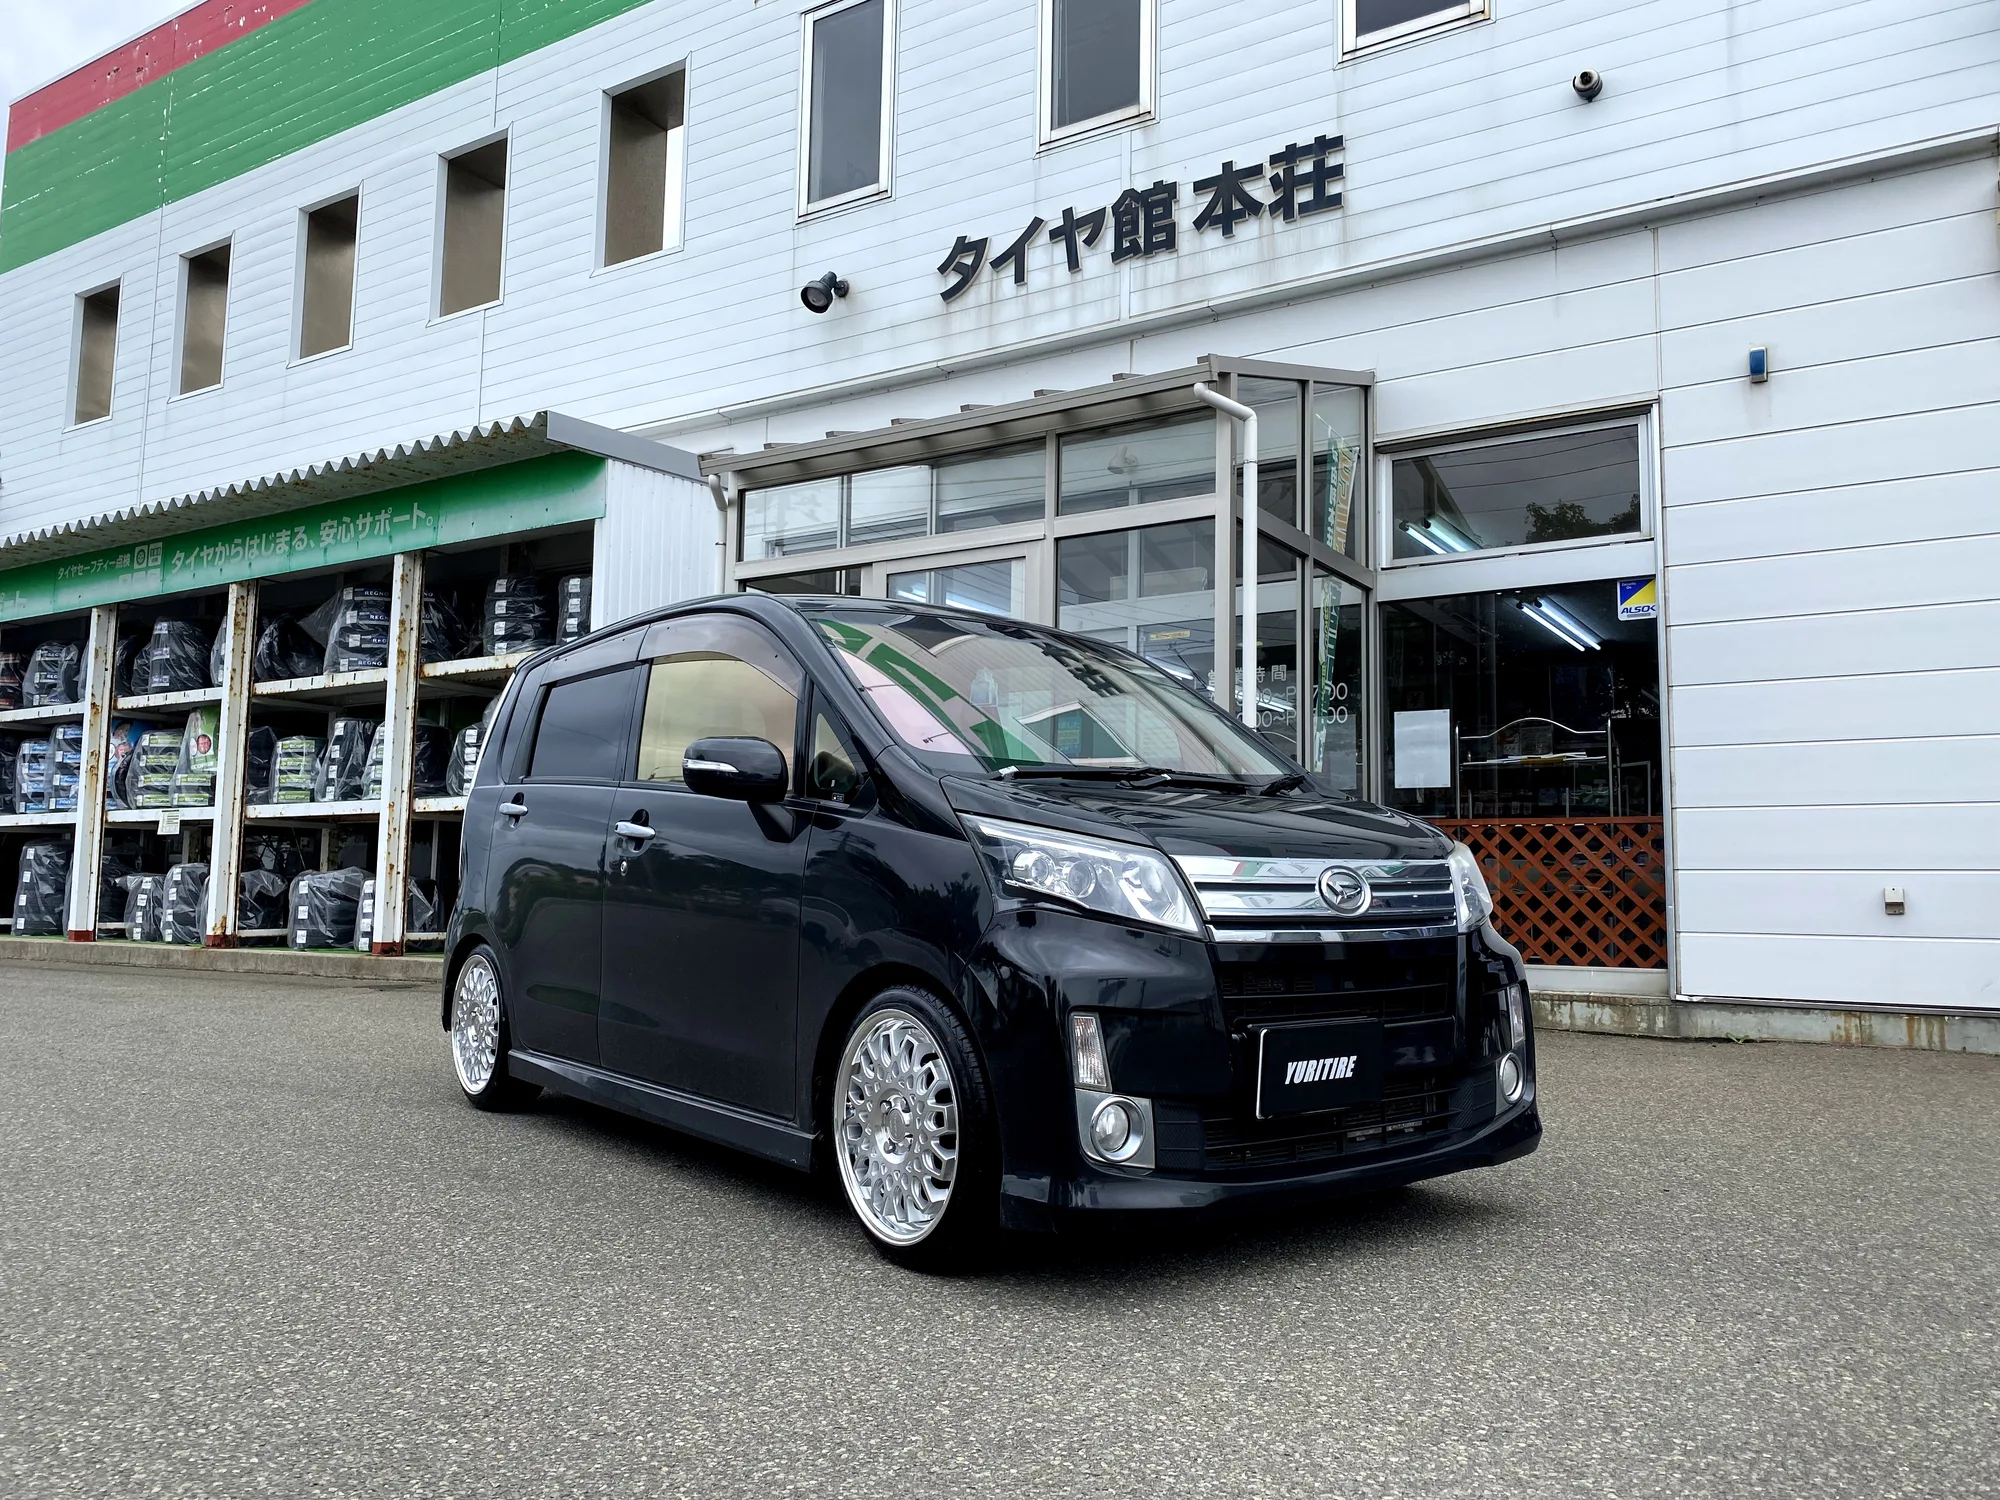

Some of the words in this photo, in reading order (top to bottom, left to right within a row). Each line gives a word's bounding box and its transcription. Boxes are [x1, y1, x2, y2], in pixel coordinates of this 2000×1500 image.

[937, 134, 1345, 304] タイヤ館本荘
[1284, 1055, 1358, 1085] YURITIRE
